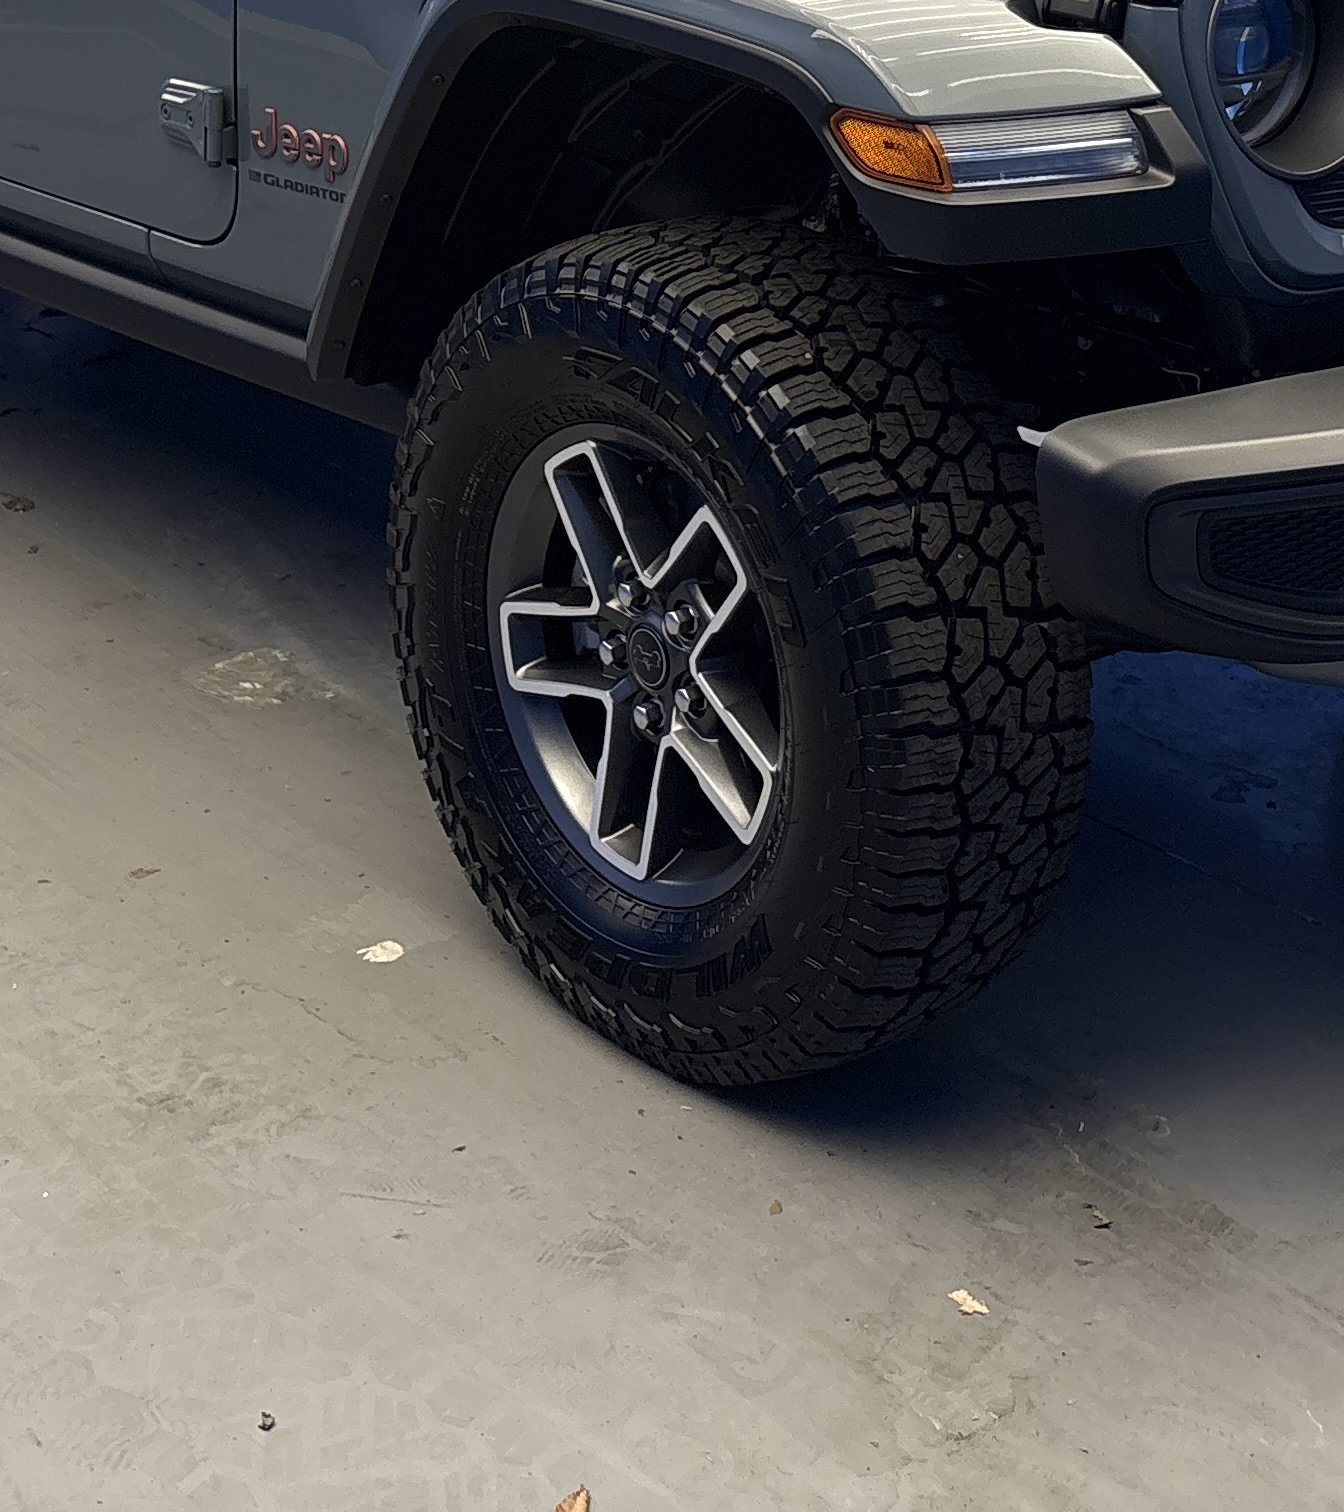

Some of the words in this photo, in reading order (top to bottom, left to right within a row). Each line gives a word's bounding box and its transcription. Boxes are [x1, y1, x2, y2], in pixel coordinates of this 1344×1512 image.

[250, 106, 349, 184] Jeep
[263, 173, 347, 204] GLADIATOR
[562, 345, 806, 649] FALKEN
